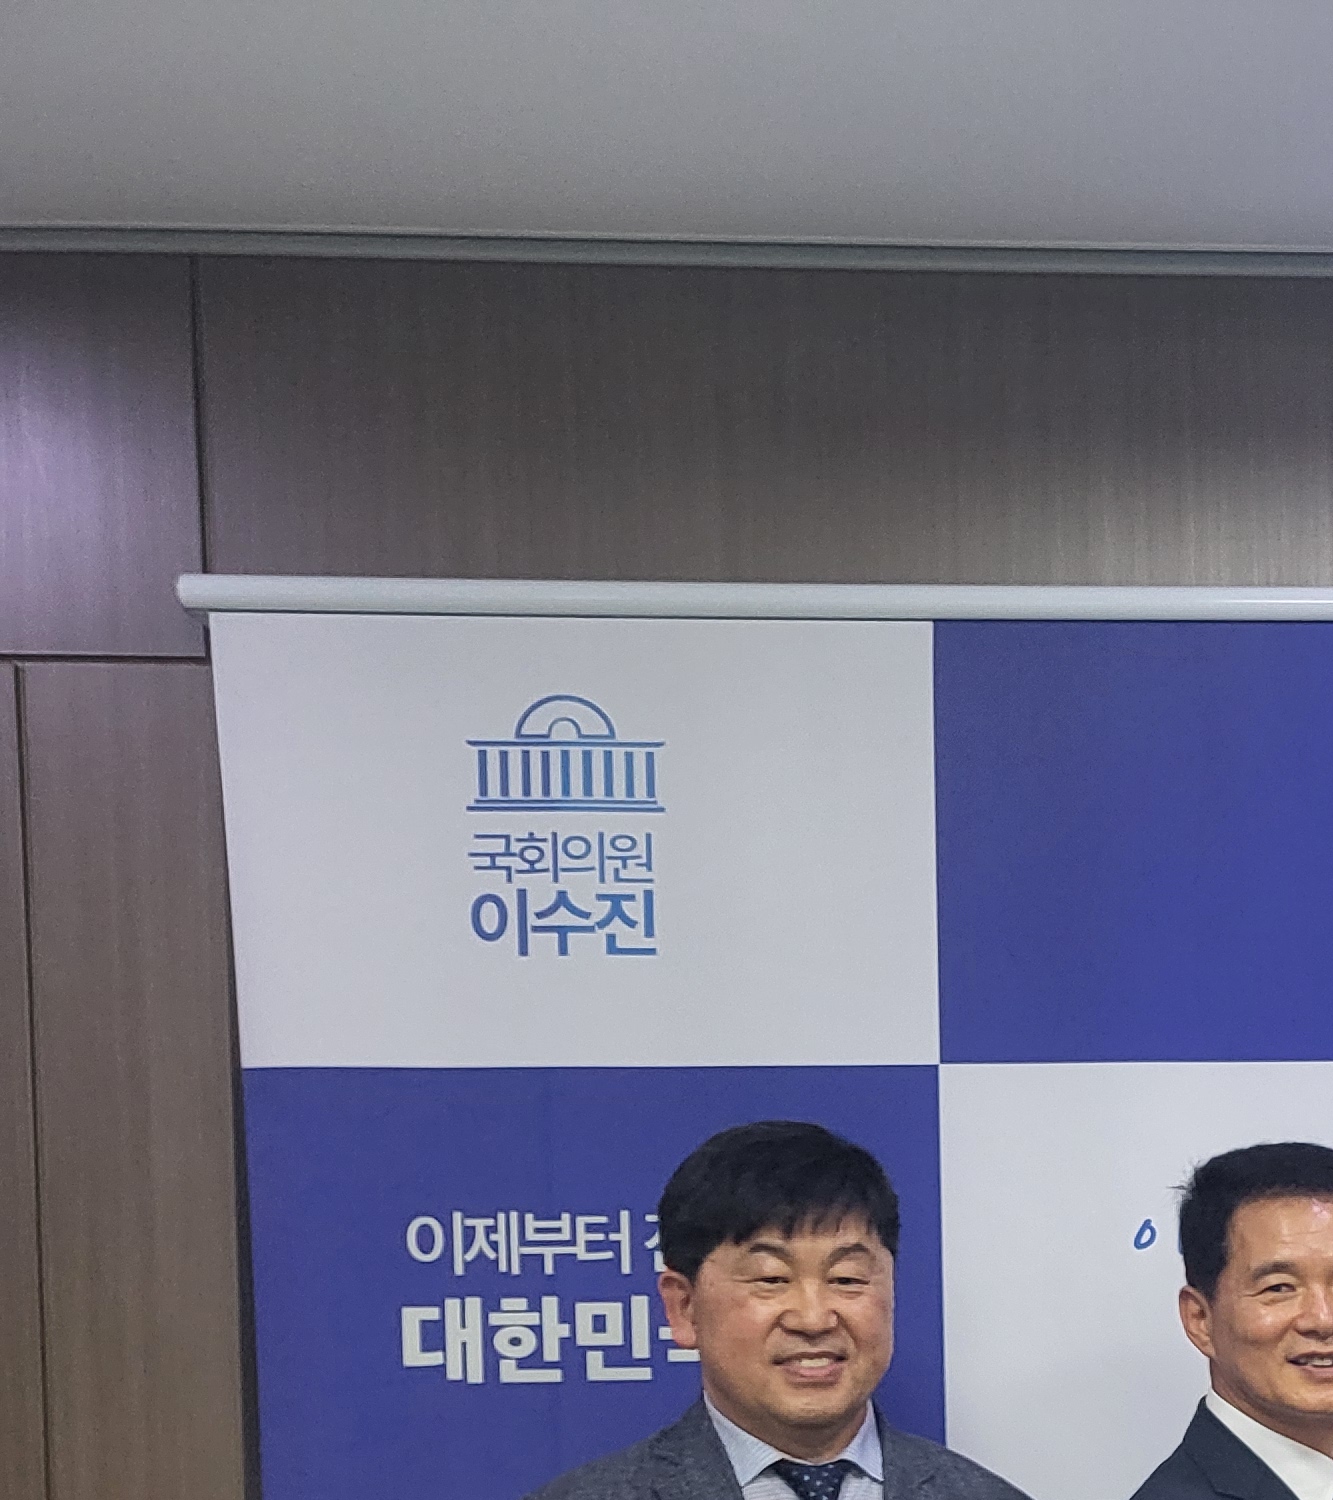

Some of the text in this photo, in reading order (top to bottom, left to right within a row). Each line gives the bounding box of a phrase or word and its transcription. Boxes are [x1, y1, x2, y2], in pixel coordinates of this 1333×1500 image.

[467, 832, 653, 883] 국회의원
[470, 888, 658, 957] 이수진
[406, 1210, 632, 1277] 이제부터
